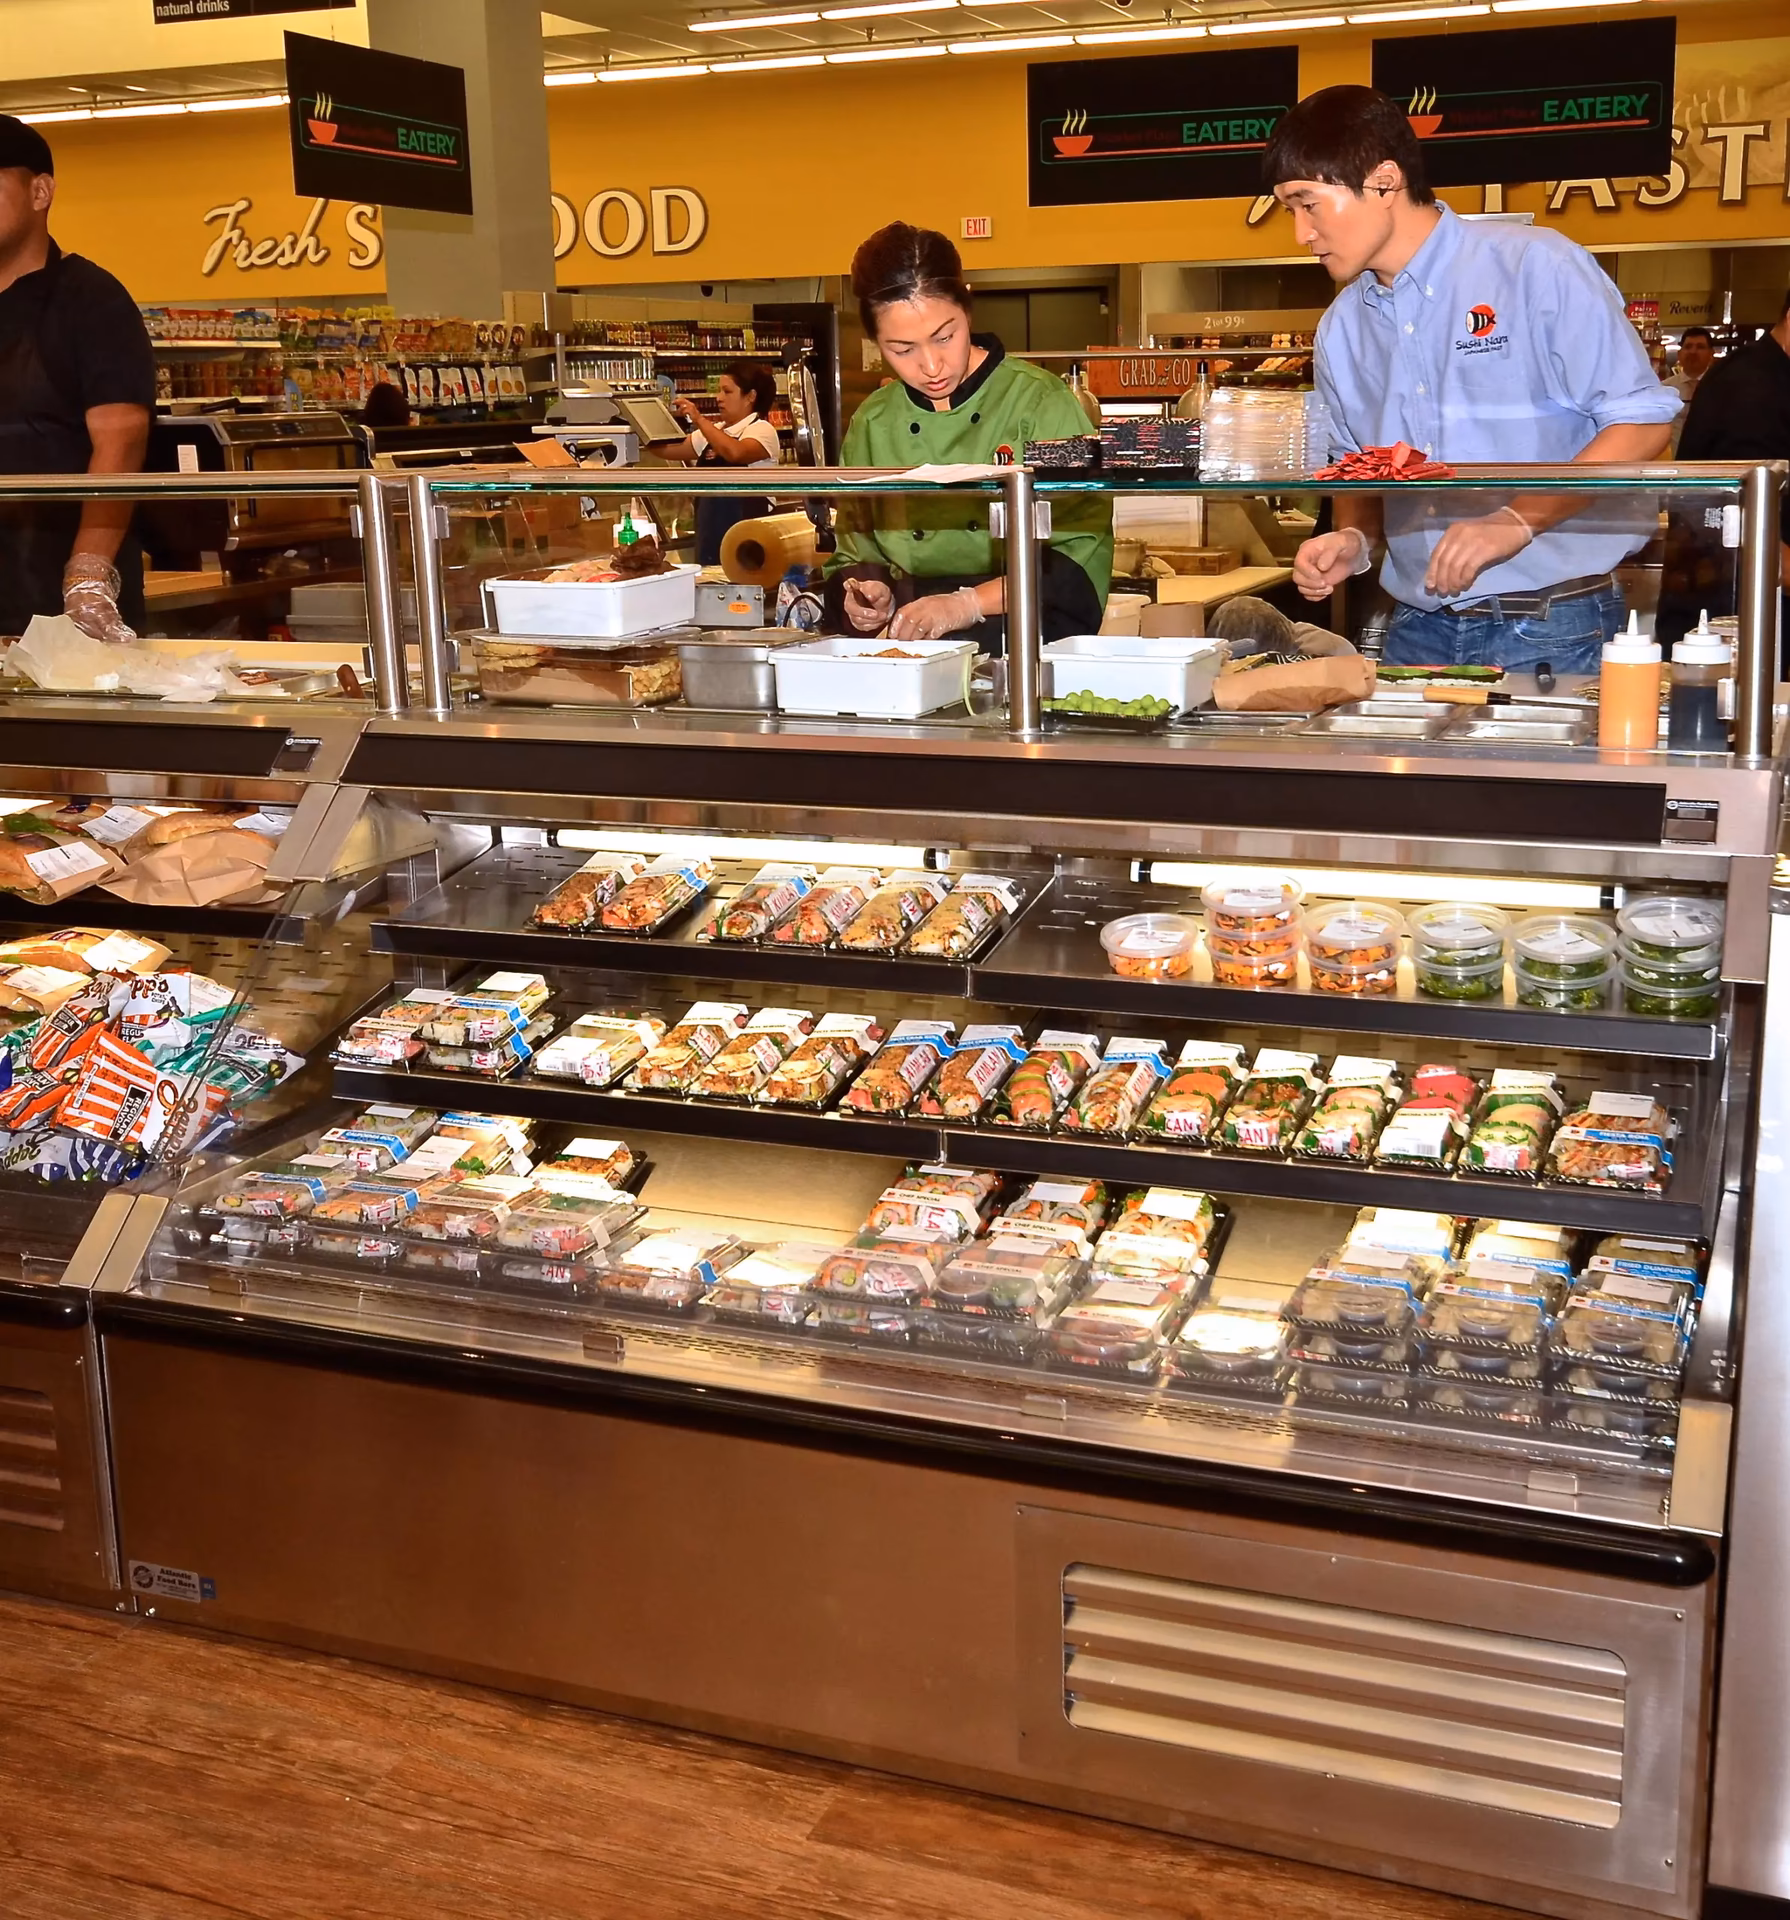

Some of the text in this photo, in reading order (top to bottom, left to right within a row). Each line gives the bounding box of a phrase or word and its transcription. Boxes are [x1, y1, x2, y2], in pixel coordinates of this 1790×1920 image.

[156, 0, 230, 17] natural drinks
[1543, 93, 1649, 123] EATERY
[1182, 117, 1277, 144] EATERY
[397, 127, 456, 156] EATERY
[201, 197, 329, 275] Fresh
[966, 218, 987, 236] EXIT
[1204, 317, 1211, 329] 2
[1120, 358, 1156, 387] GRAB
[1172, 358, 1191, 386] GO
[114, 1097, 134, 1130] FLAVOR
[117, 1096, 142, 1135] REGULAR
[1014, 1222, 1057, 1233] CHEF SPECIAL
[995, 1266, 1023, 1274] SPECIAL
[1518, 1257, 1566, 1269] DUMPLING
[1617, 1260, 1693, 1276] FRIED DUMPLING
[160, 1568, 192, 1580] Atlantic
